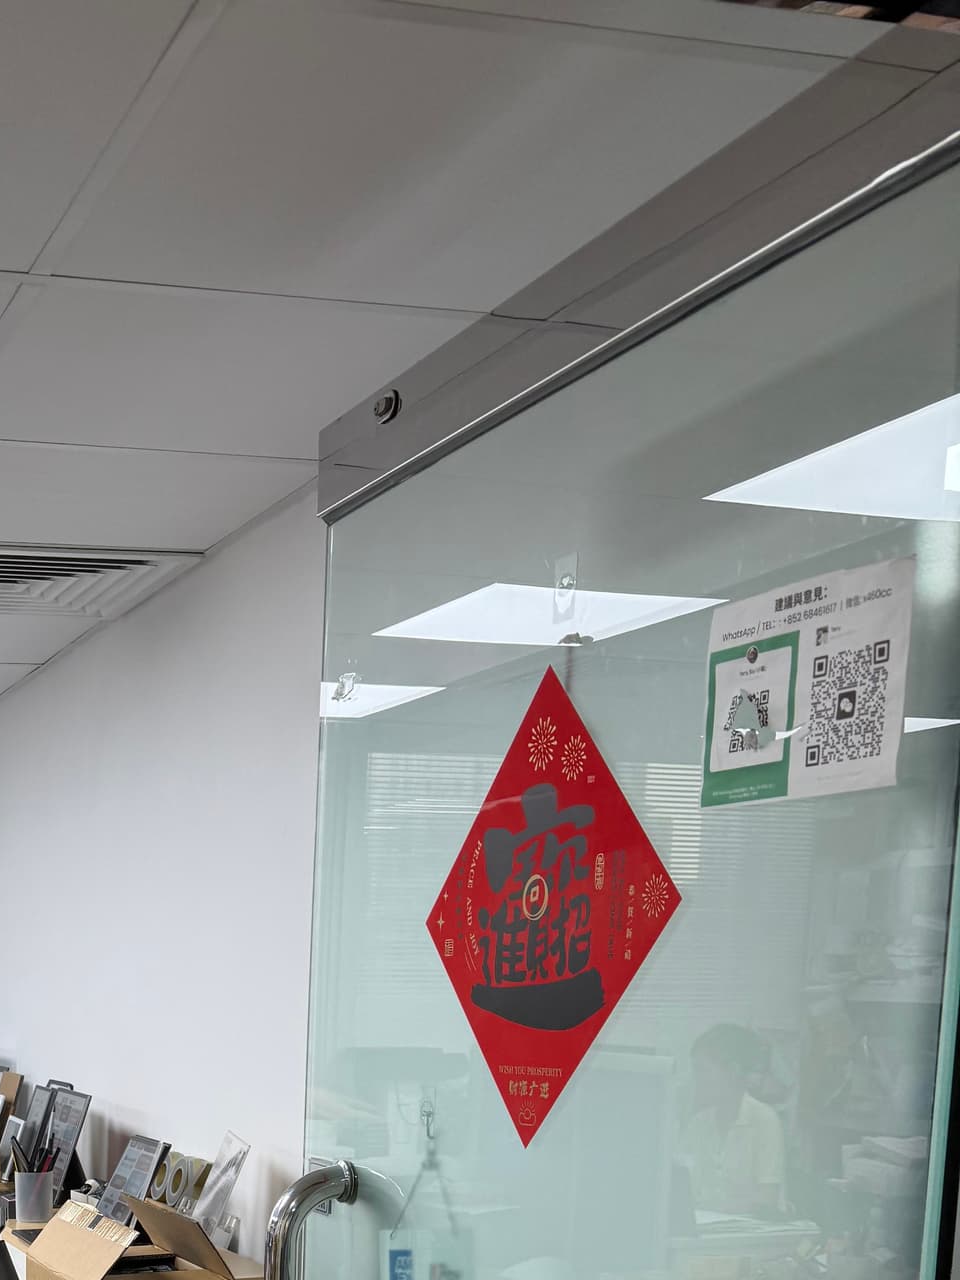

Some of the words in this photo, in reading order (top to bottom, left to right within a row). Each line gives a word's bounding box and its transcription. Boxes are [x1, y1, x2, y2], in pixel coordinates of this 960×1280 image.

[722, 626, 756, 642] WhatsApp
[467, 839, 483, 888] PEACE
[468, 931, 480, 956] JOY
[498, 1064, 514, 1074] WISH
[514, 1066, 527, 1075] YOU
[527, 1066, 562, 1078] PROSPERITY
